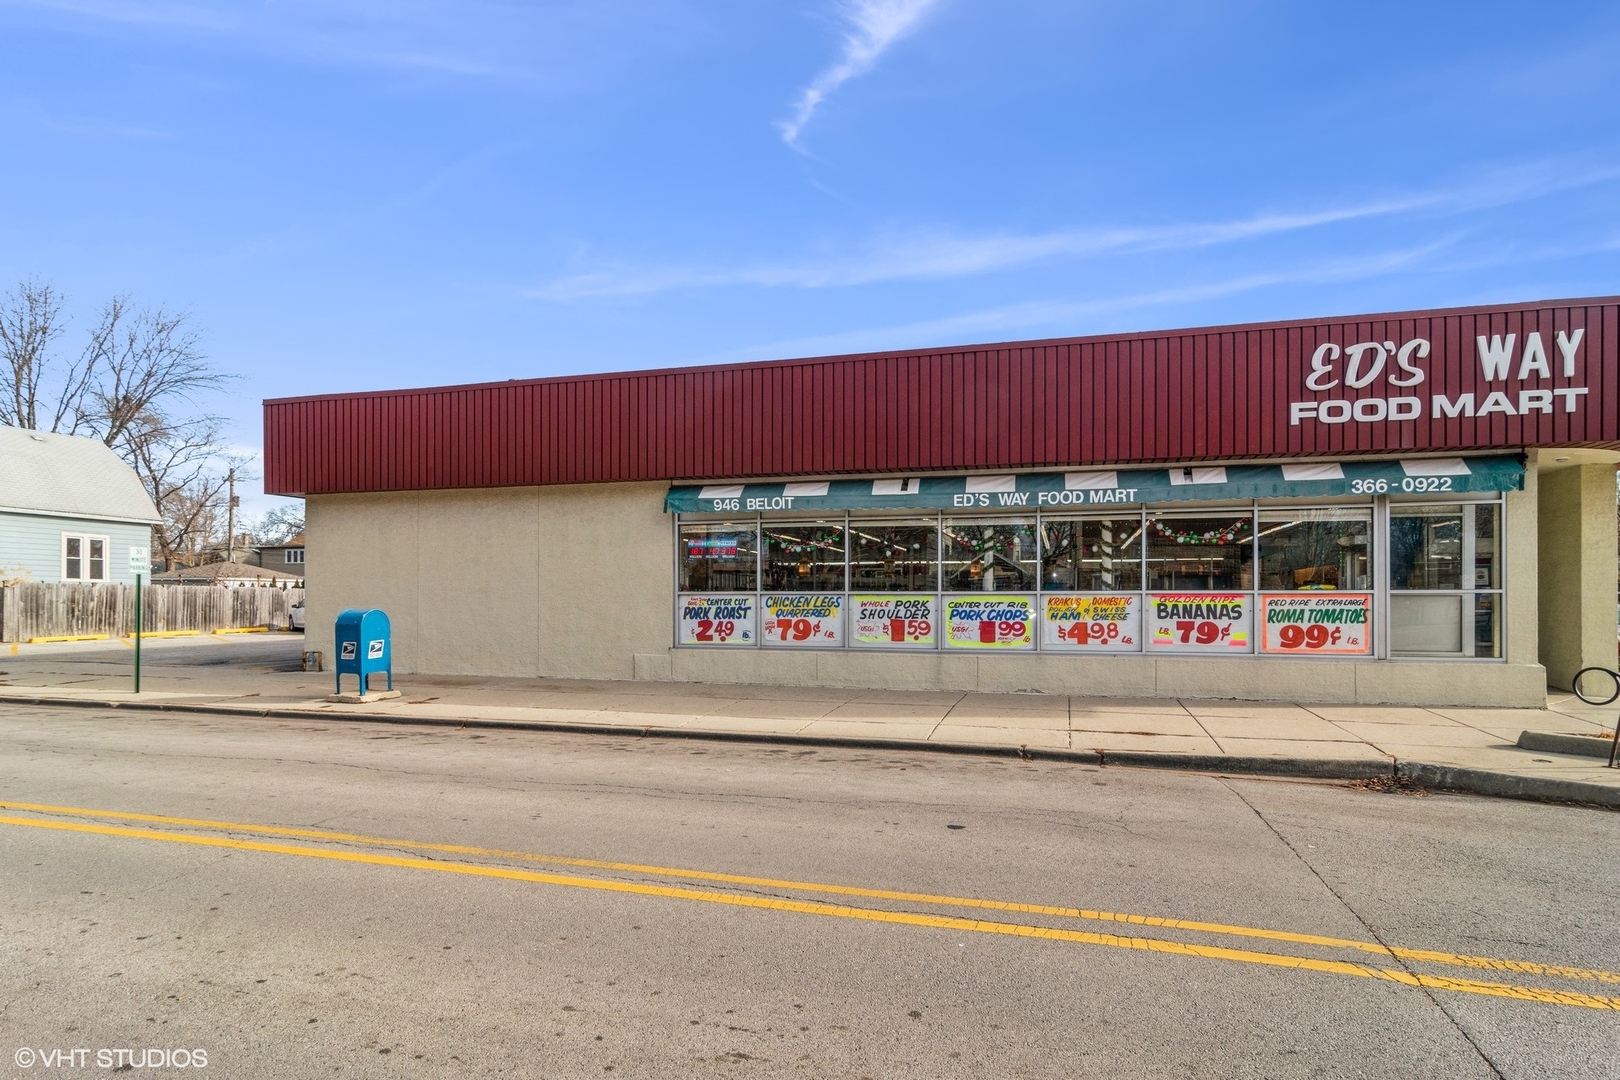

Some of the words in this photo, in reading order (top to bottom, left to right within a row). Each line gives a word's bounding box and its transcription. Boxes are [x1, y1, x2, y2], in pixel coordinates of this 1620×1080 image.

[1305, 338, 1430, 391] ED'S
[1476, 328, 1585, 382] WAY
[1290, 396, 1422, 426] FOOD
[1432, 387, 1588, 419] MART
[953, 493, 990, 507] ED'S
[998, 491, 1030, 506] WAY
[1038, 490, 1084, 505] FOOD
[1089, 488, 1138, 503] MART
[713, 499, 740, 511] 946
[746, 497, 795, 510] BELOIT
[707, 598, 733, 606] CENTER
[734, 598, 749, 606] CUT
[766, 596, 814, 608] CHICKEN
[813, 596, 842, 608] LEGS
[860, 600, 891, 608] WHOLE
[894, 600, 929, 609] PORK
[948, 601, 981, 609] CENTER
[1047, 597, 1082, 606] KRAKUS
[1092, 596, 1133, 606] DOMESTIC
[1159, 595, 1207, 603] GOLDEN
[1209, 595, 1238, 604] RIPE
[1344, 598, 1368, 606] LARGE
[683, 606, 712, 620] PORK
[713, 606, 752, 620] ROAST
[776, 608, 831, 618] QUARTERED
[860, 608, 931, 620] SHOULDER
[949, 609, 986, 621] PORK
[986, 609, 1030, 621] CHOPS
[1050, 612, 1081, 620] HAM
[1092, 612, 1130, 621] CHEESE
[1157, 603, 1243, 620] BANANAS
[1267, 608, 1305, 624] ROMA
[1307, 608, 1370, 624] TOMATOES
